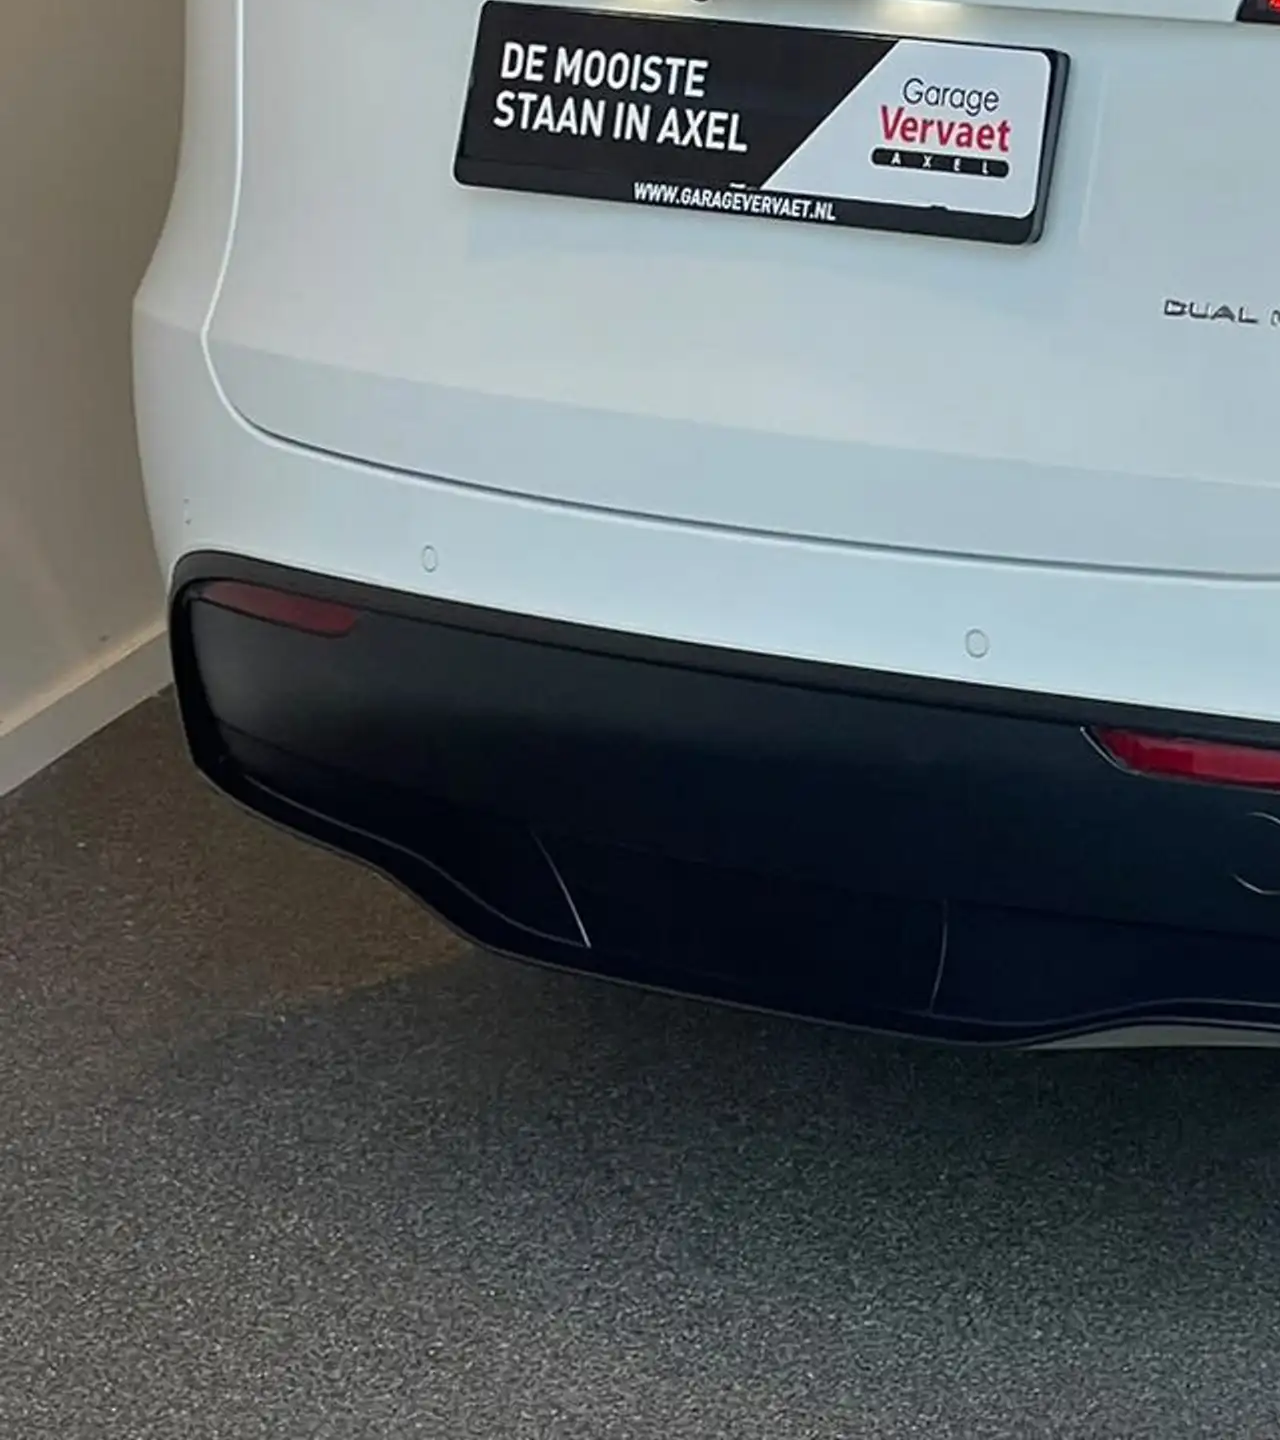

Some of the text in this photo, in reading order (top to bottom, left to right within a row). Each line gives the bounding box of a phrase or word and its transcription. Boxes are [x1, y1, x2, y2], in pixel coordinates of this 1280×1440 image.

[501, 42, 708, 98] DE MOOISTE
[902, 77, 1001, 117] Garage
[493, 90, 748, 152] STAAN IN AXEL
[881, 104, 1011, 153] Vervaet
[634, 182, 836, 221] WWW.GARAGEVERVAET.NL
[1163, 299, 1259, 324] DUAL
